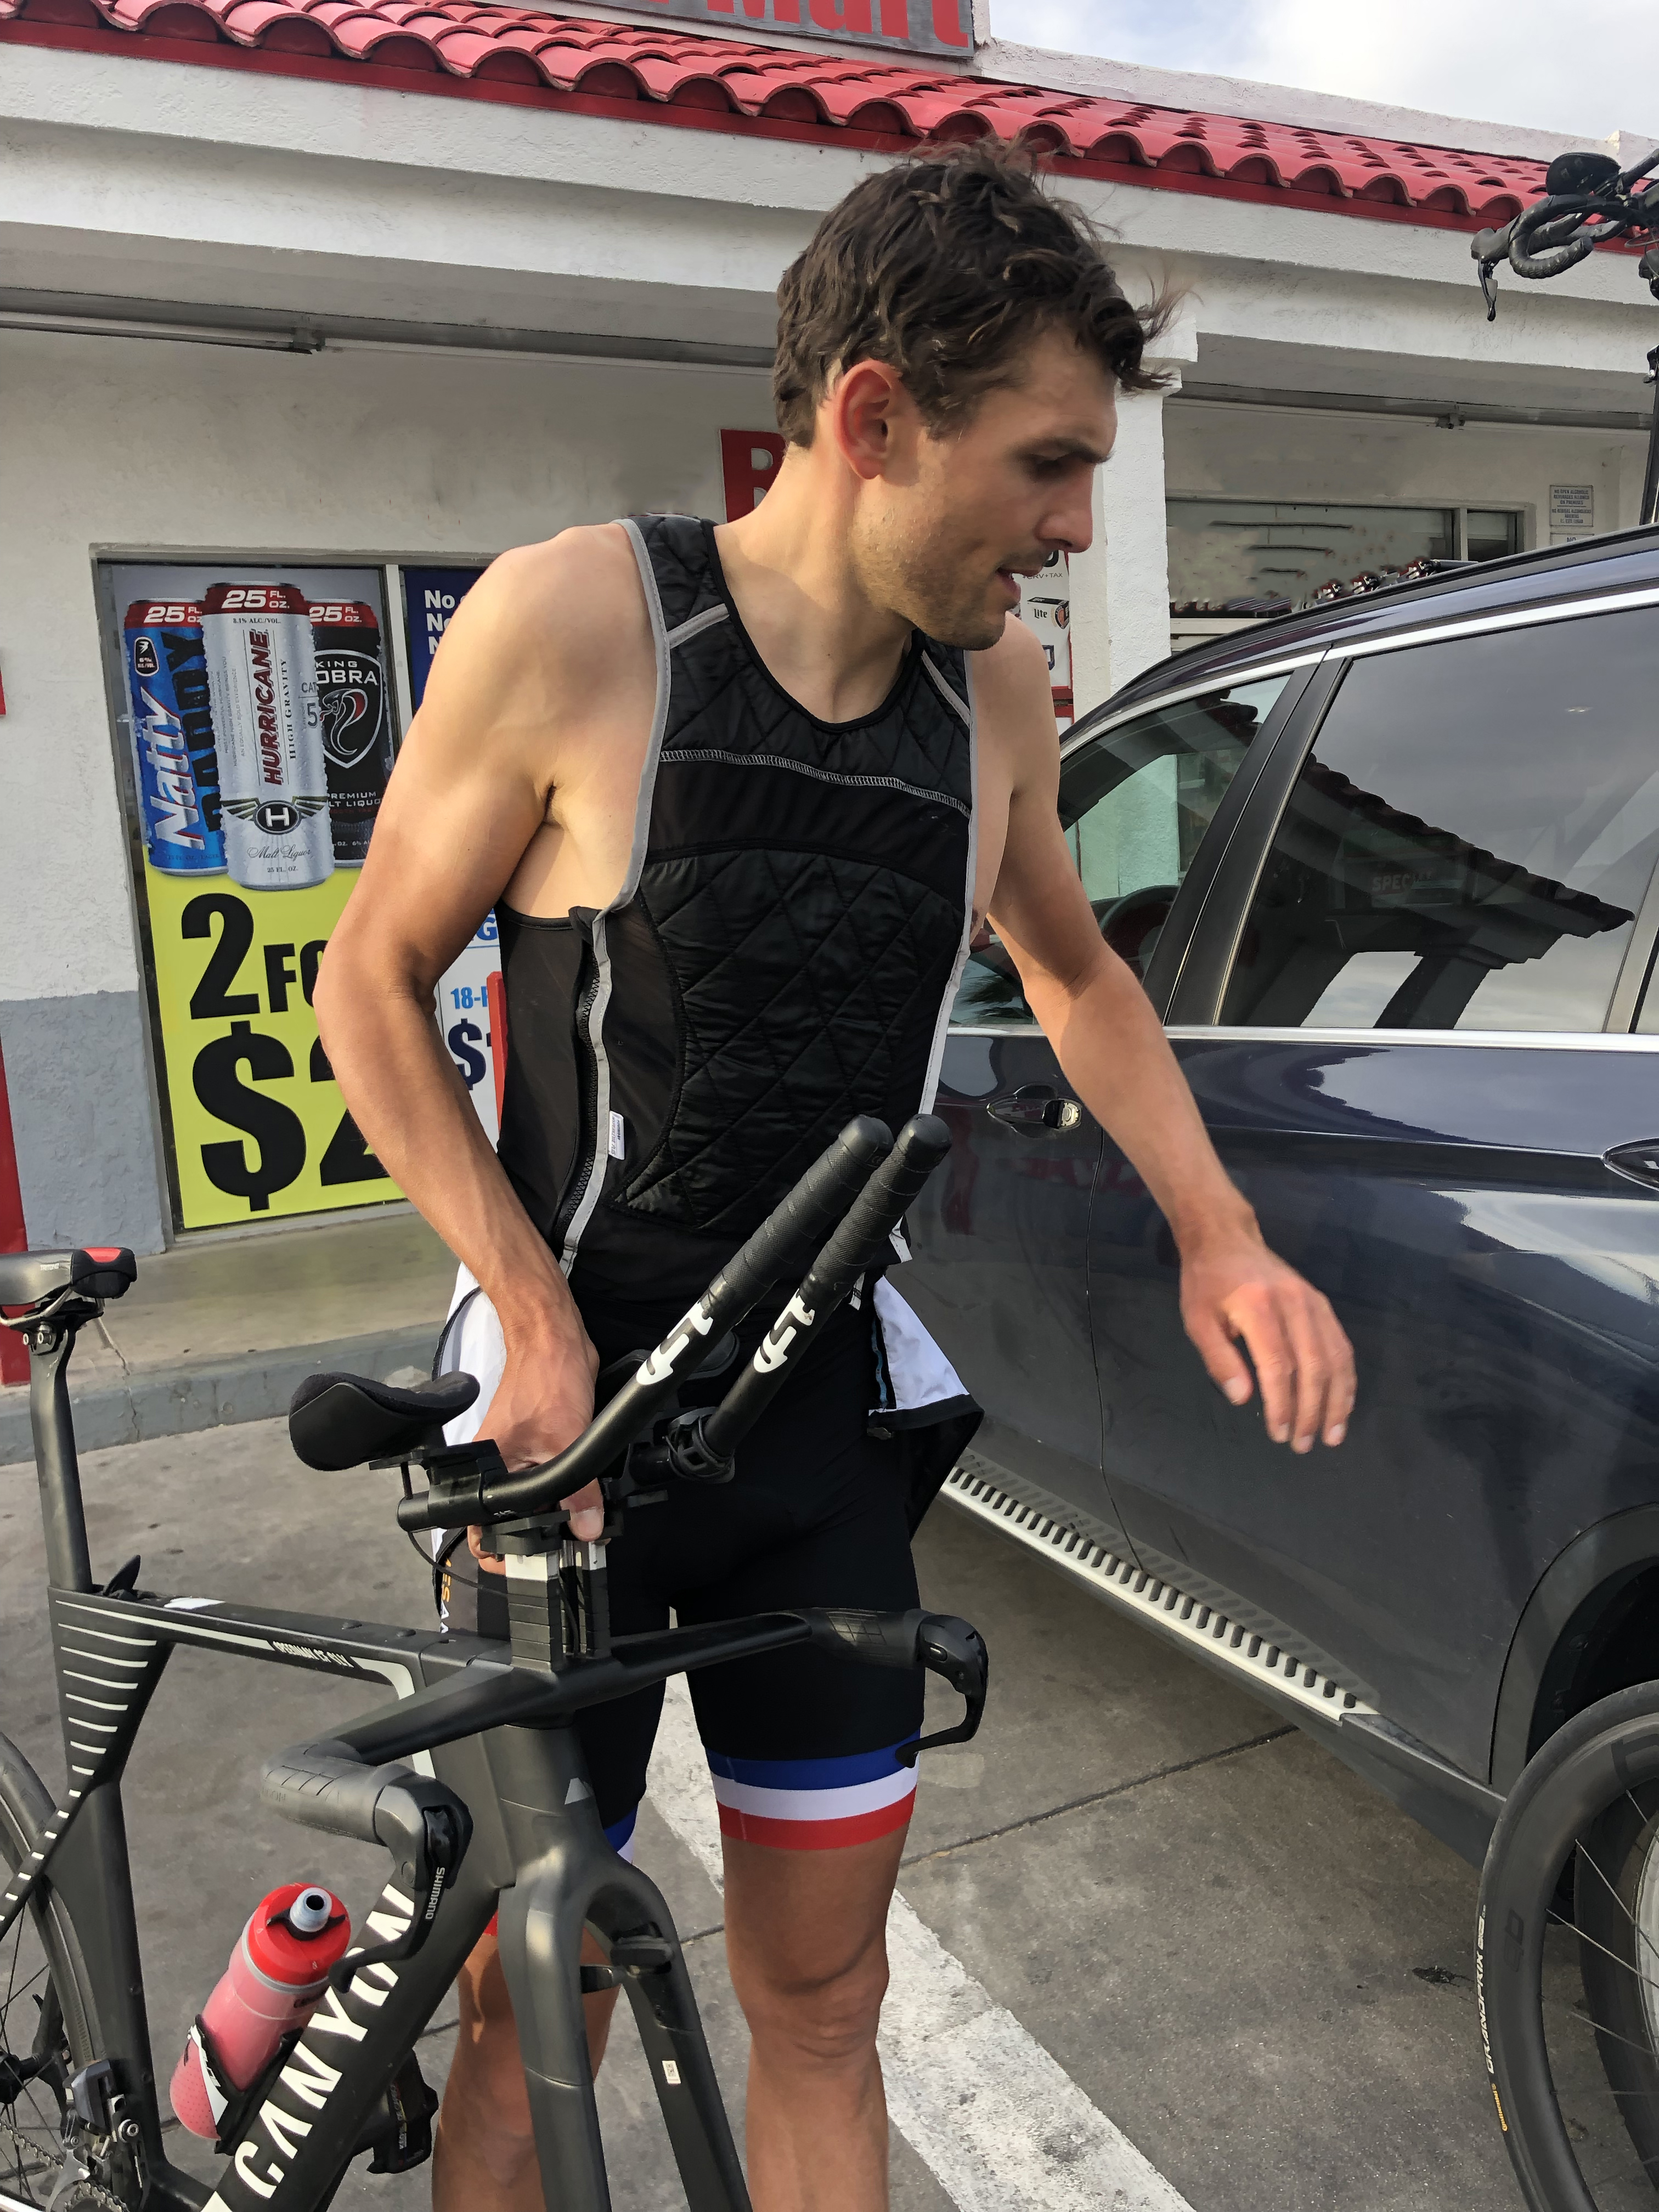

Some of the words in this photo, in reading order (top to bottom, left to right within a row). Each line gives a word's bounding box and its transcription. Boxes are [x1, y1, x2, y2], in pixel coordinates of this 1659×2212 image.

[221, 590, 267, 609] 25
[270, 590, 286, 599] FL.
[425, 590, 455, 608] No
[144, 606, 185, 623] 25
[309, 606, 342, 622] 25
[1034, 608, 1048, 619] Lite
[280, 659, 292, 718] GRAVITY
[250, 628, 284, 785] HURRICANE
[307, 702, 318, 729] 5
[287, 724, 296, 759] HIGH
[140, 686, 205, 850] Natty
[266, 807, 290, 827] H
[247, 846, 281, 859] Malt
[280, 844, 312, 861] Liquor
[181, 893, 261, 1020] 2
[425, 1866, 446, 1920] SHIMANO
[235, 1883, 415, 2199] CANYON
